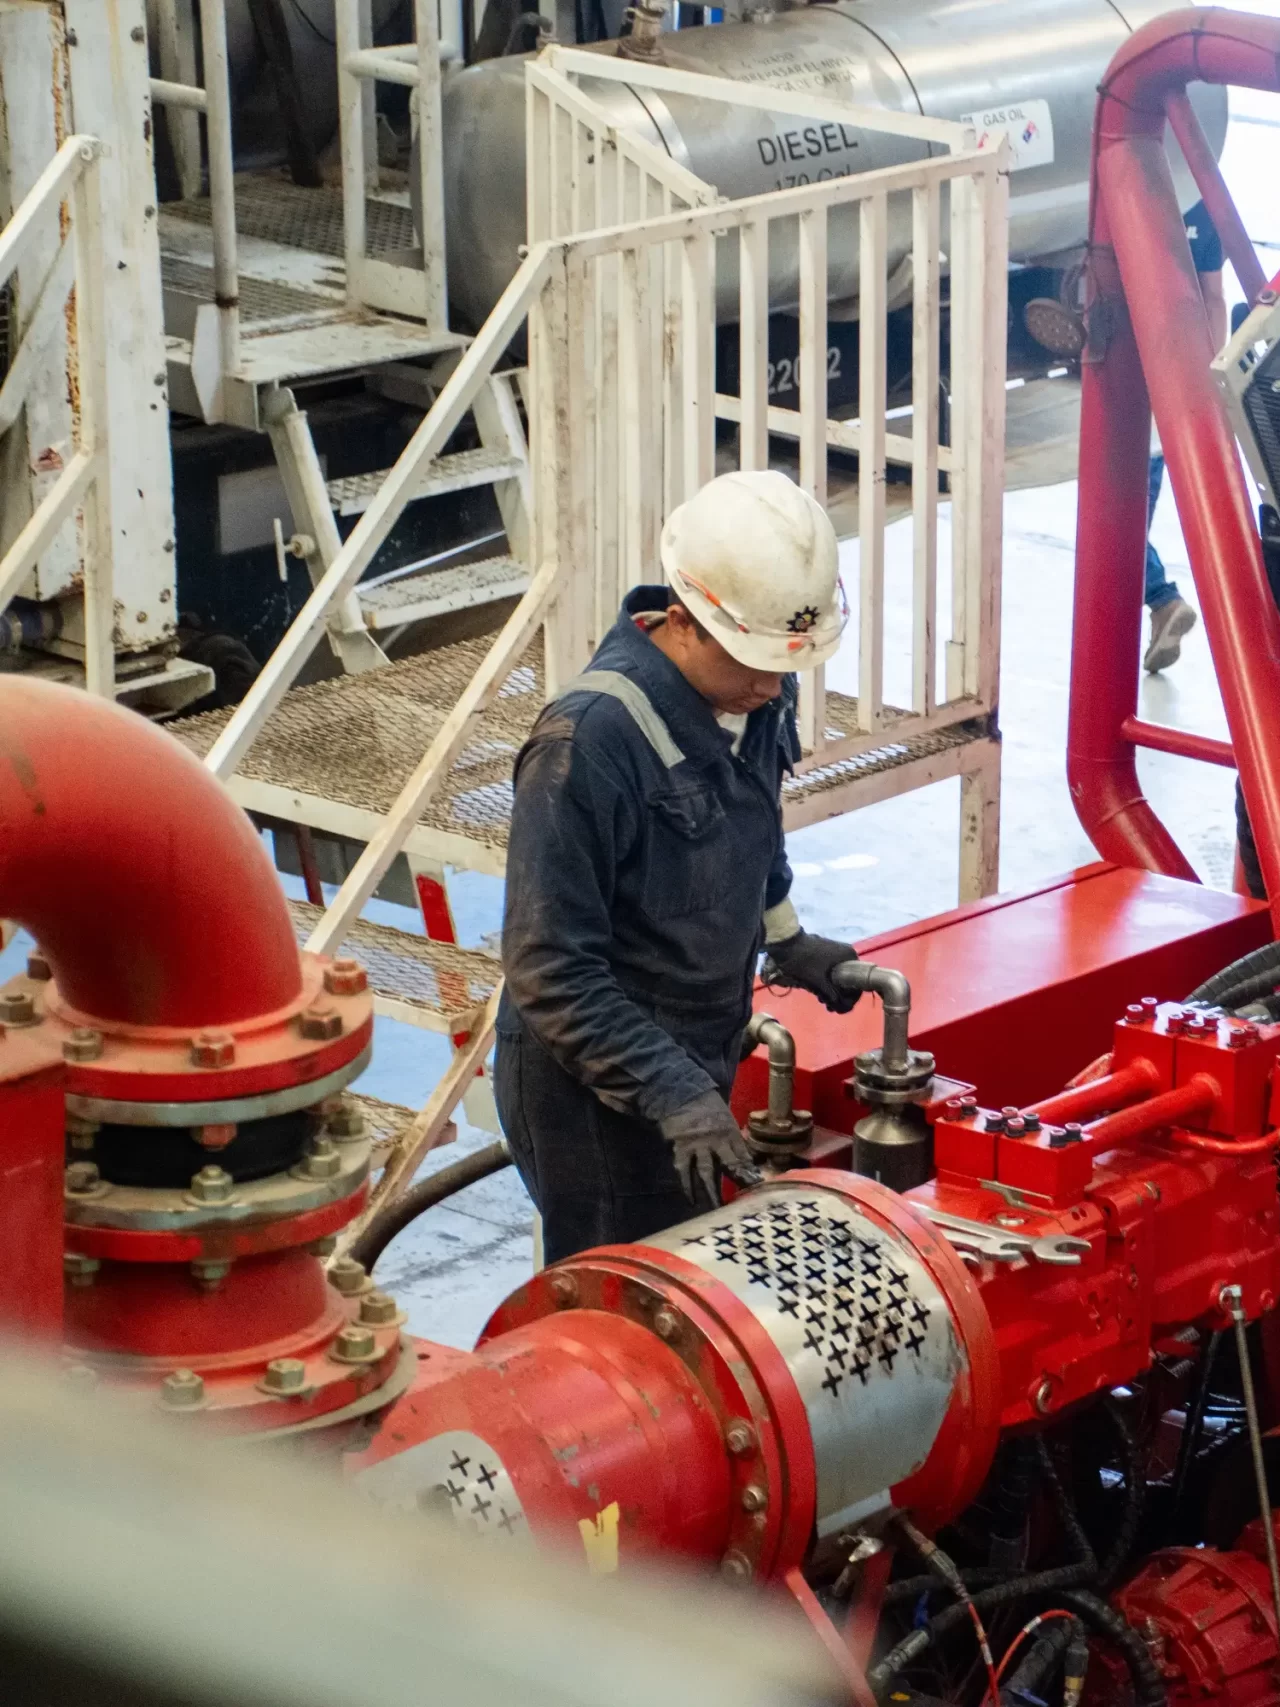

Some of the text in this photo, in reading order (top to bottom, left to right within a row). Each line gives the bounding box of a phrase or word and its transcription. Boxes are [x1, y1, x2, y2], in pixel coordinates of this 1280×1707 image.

[983, 107, 1026, 127] GAS OIL
[757, 122, 858, 166] DIESEL
